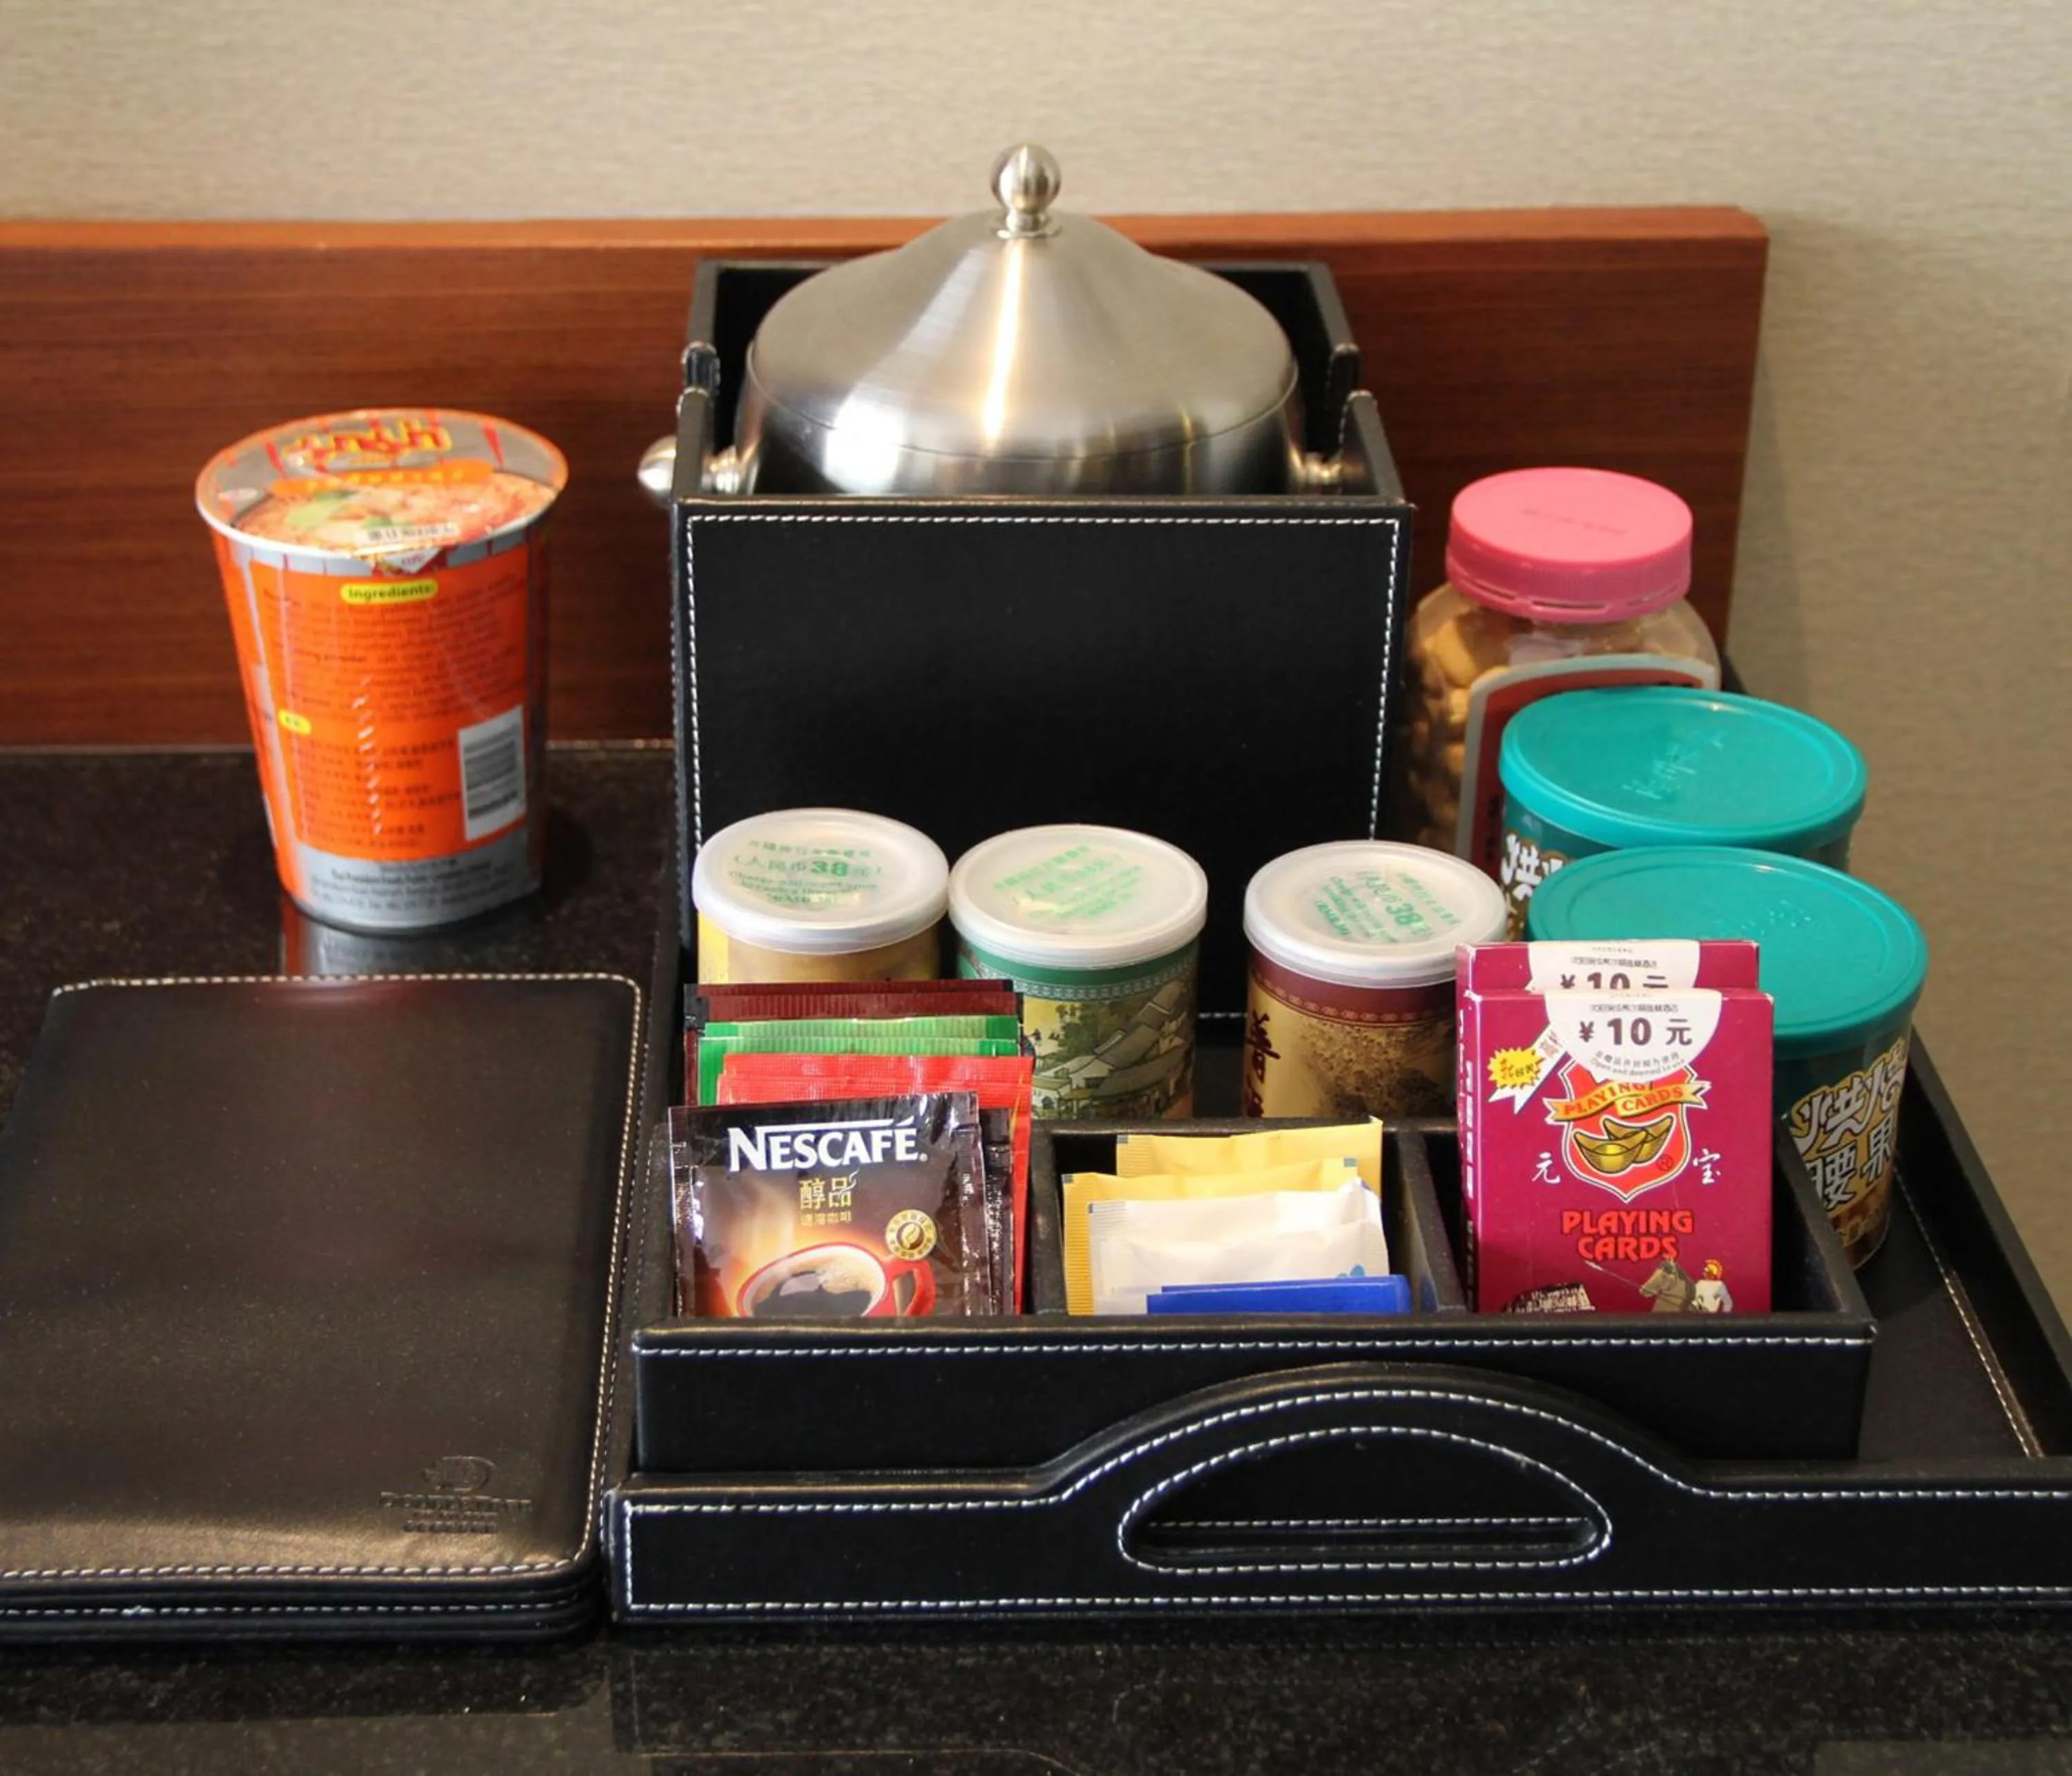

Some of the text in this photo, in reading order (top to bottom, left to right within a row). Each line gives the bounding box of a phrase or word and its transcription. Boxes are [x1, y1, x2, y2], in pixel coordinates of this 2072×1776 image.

[1607, 1017, 1652, 1045] 10
[1666, 1019, 1692, 1045] 元
[1621, 1085, 1684, 1112] CARDS
[727, 1115, 919, 1172] NESCAFÉ
[798, 1176, 853, 1210] 醇品
[1562, 1209, 1694, 1236] PLAYING
[1577, 1235, 1680, 1262] CARDS
